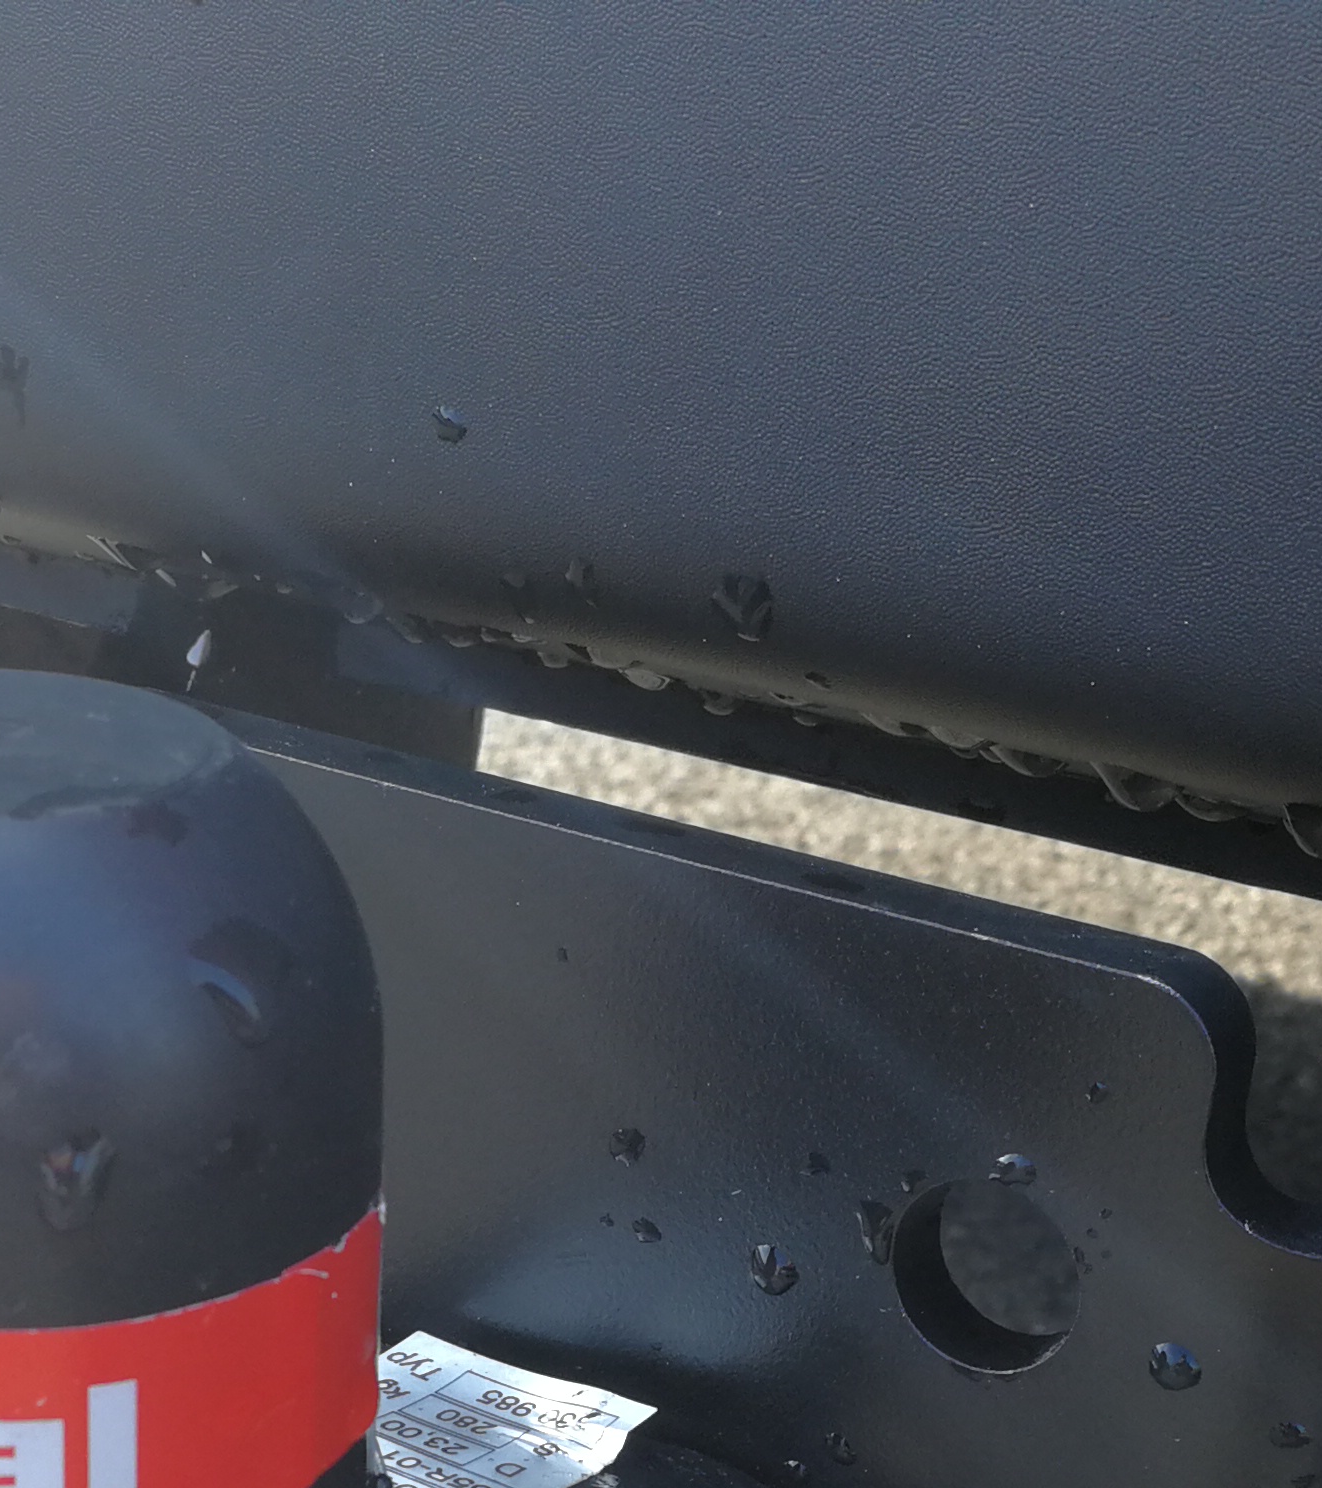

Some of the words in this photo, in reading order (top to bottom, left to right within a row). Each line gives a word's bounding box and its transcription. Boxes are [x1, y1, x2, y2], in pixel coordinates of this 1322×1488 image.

[386, 1351, 443, 1382] Typ
[475, 1389, 537, 1417] 985
[435, 1409, 499, 1435] 280
[379, 1419, 469, 1455] 23,00
[494, 1462, 527, 1478] D
